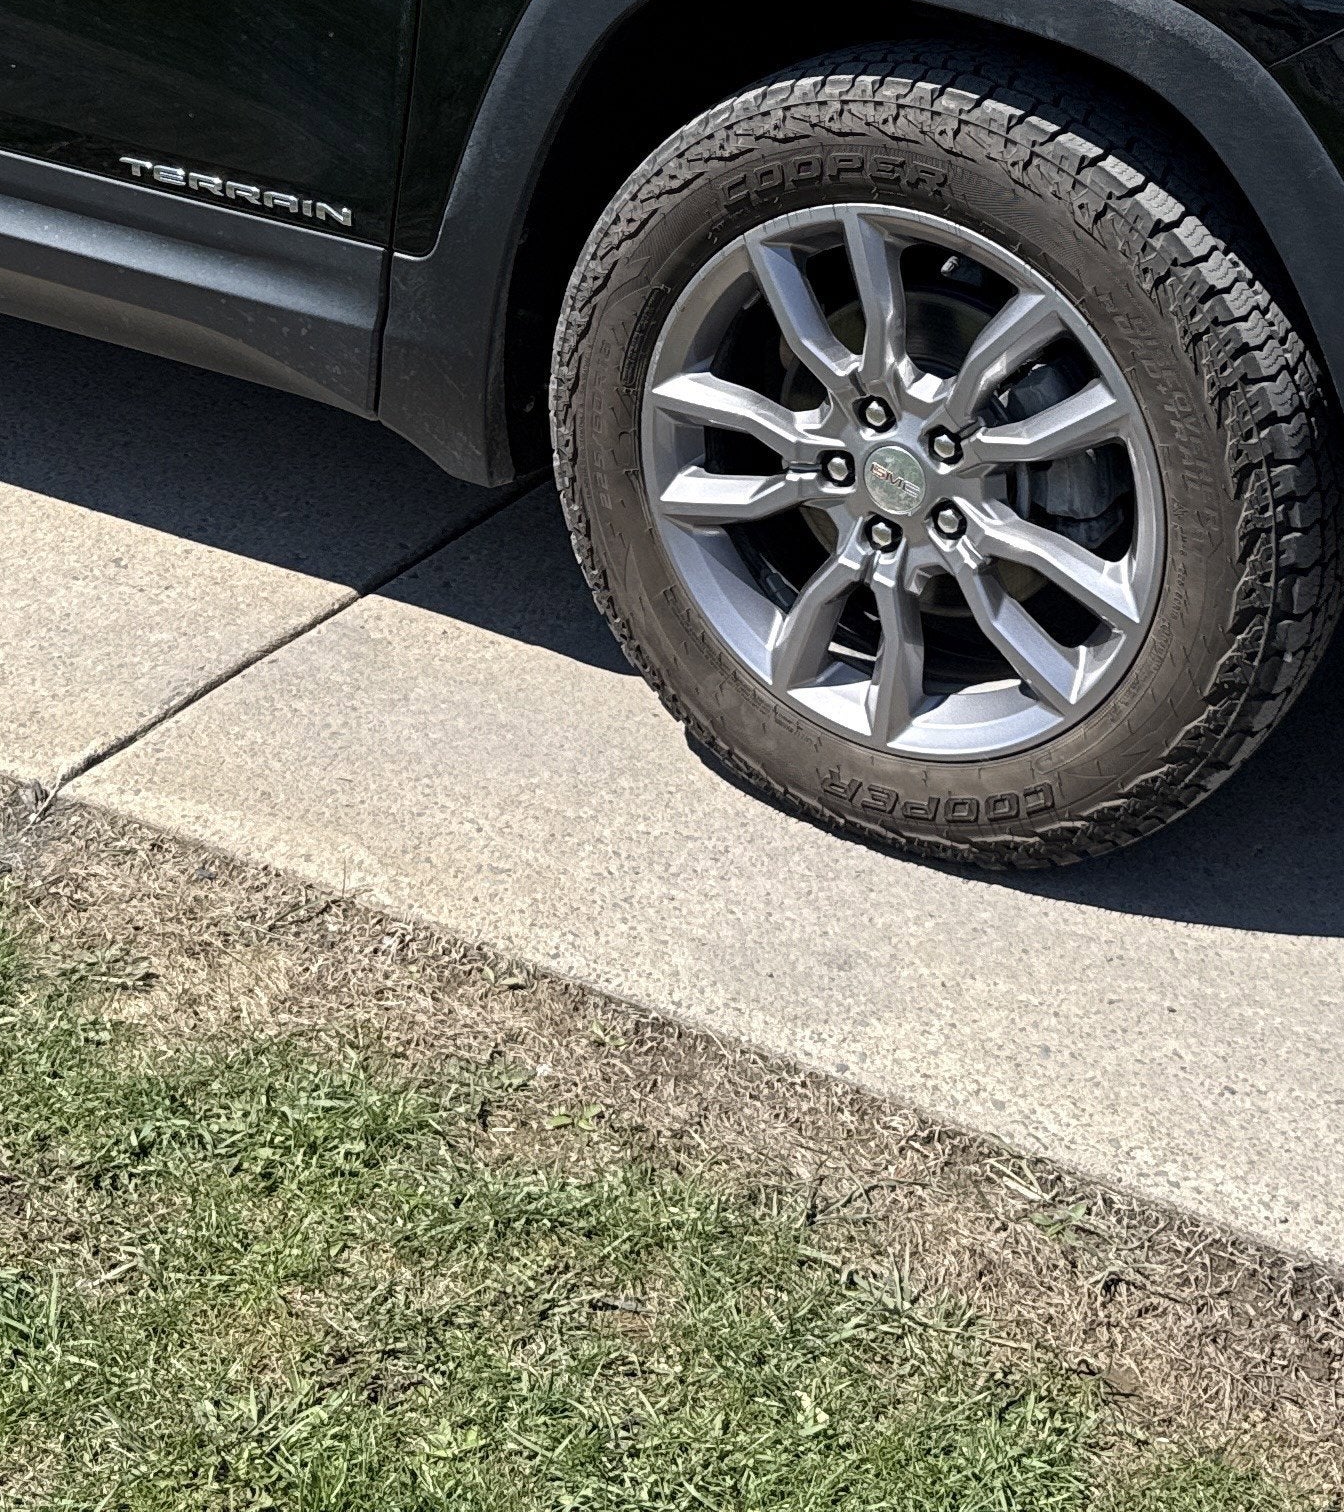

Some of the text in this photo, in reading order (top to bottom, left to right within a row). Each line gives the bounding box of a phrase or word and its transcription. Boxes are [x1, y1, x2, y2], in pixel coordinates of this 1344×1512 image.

[119, 156, 353, 227] TERRAIN
[720, 152, 950, 211] COOPER
[870, 461, 920, 499] GMC
[820, 768, 1057, 824] COOPER
